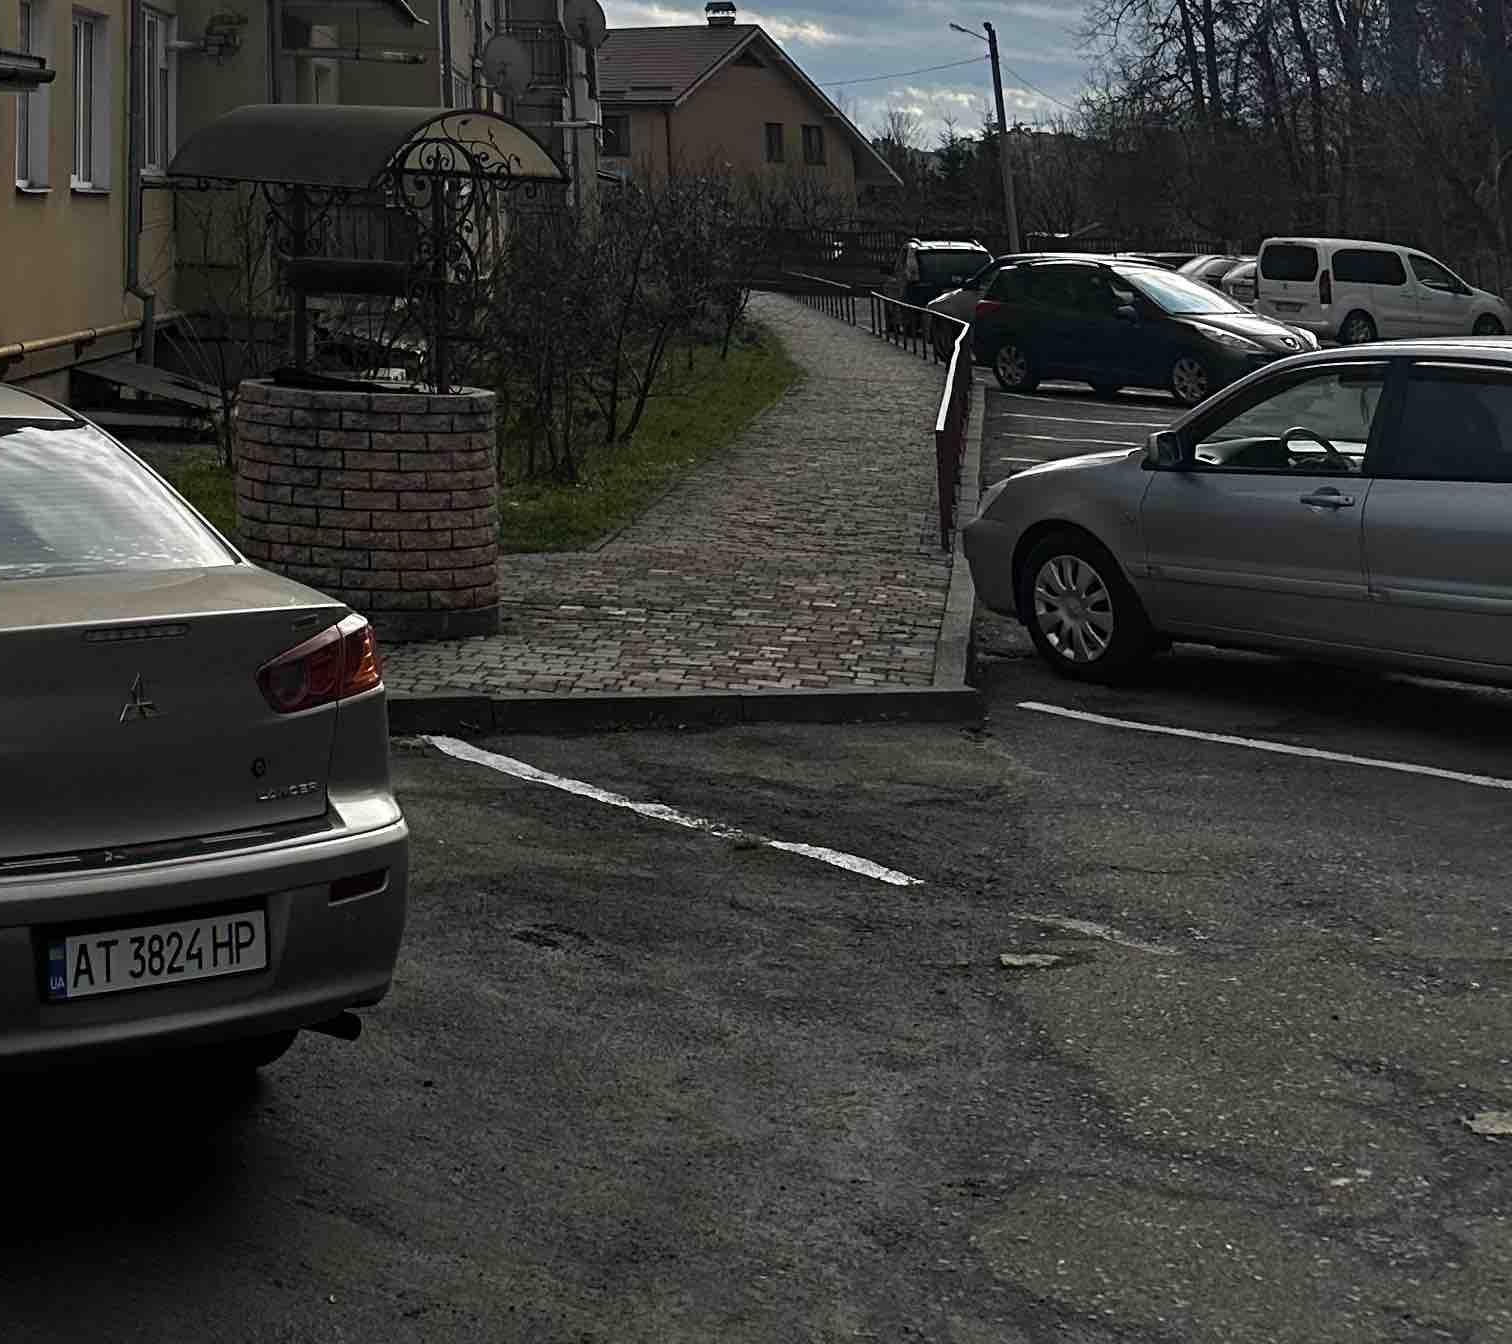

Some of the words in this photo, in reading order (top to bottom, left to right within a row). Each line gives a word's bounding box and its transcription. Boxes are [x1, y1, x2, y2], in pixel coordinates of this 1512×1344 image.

[73, 940, 119, 988] AT
[128, 926, 204, 979] 3824
[212, 921, 256, 967] HP
[48, 975, 66, 992] UA
